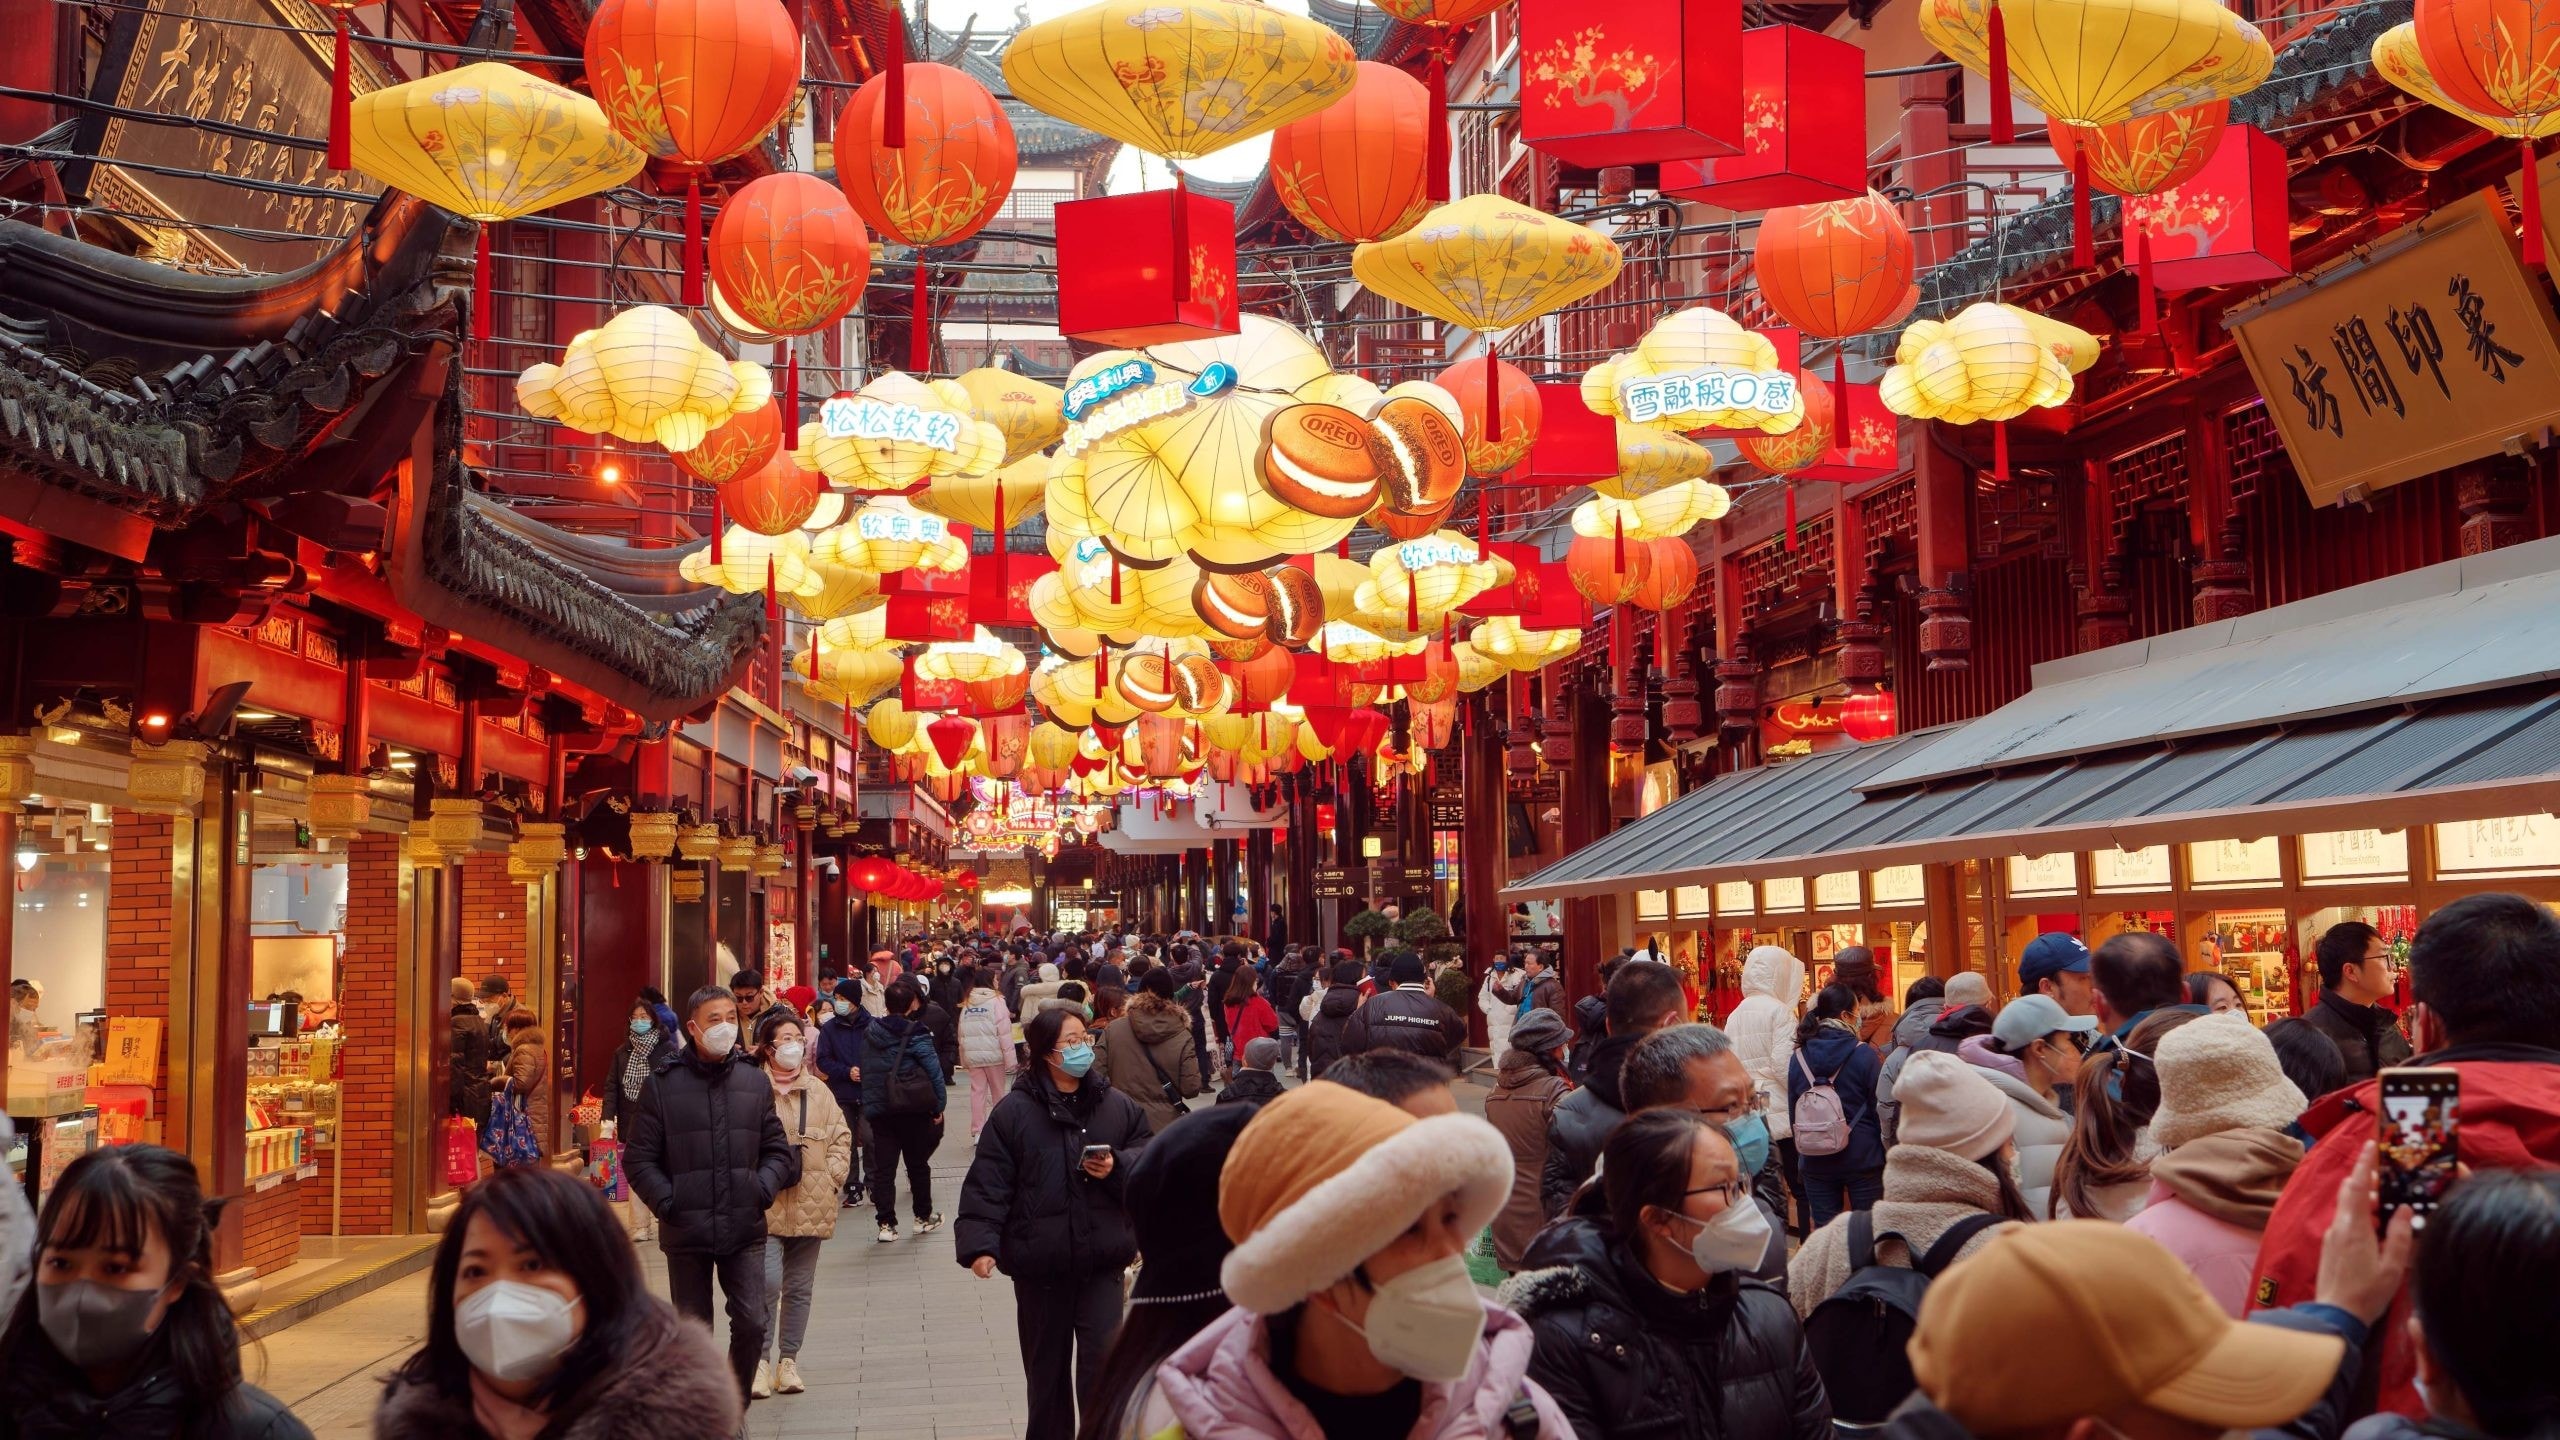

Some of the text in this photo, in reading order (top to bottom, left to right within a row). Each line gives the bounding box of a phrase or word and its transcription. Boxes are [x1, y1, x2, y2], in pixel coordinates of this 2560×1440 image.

[1066, 362, 1144, 414] 奥利奥
[1203, 371, 1218, 389] 新
[1630, 376, 1792, 417] 雪融般口感
[826, 402, 956, 448] 松松软软
[1306, 417, 1359, 447] OREO
[1424, 418, 1453, 463] OREO
[861, 515, 940, 541] 软奥奥
[1235, 573, 1261, 592] REO
[1302, 580, 1317, 615] OREO
[1144, 661, 1163, 674] ORE
[1205, 665, 1217, 689] OREO
[608, 1192, 616, 1200] 70
